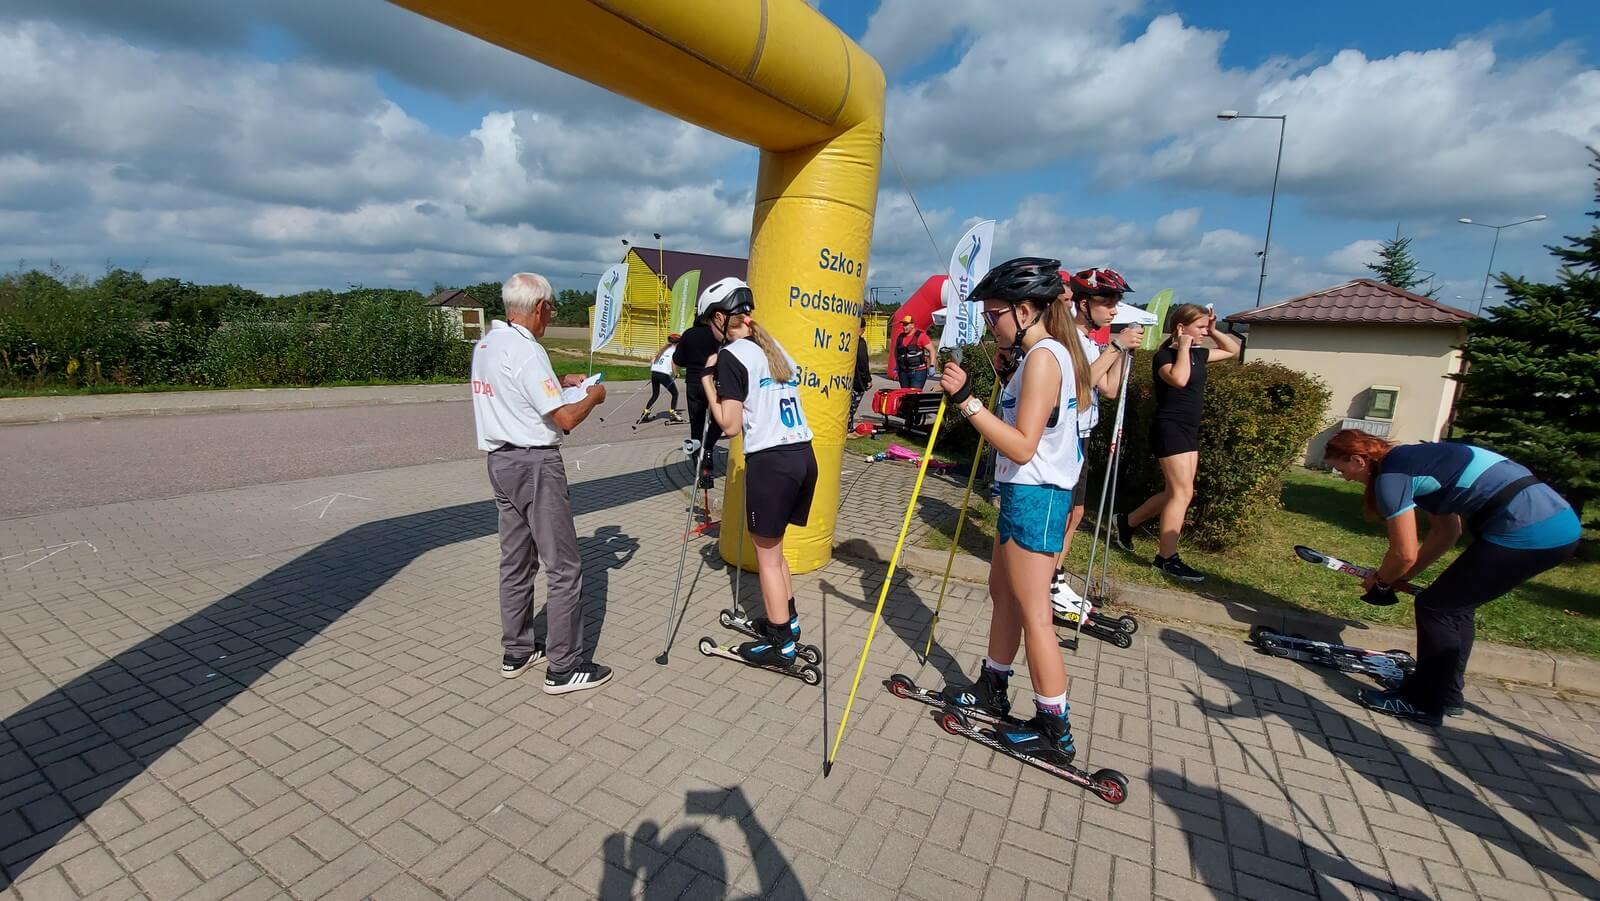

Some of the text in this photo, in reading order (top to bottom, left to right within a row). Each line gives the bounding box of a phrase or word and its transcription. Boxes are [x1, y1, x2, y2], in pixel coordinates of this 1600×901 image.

[599, 294, 610, 339] Szelment
[814, 327, 851, 353] Nr 32
